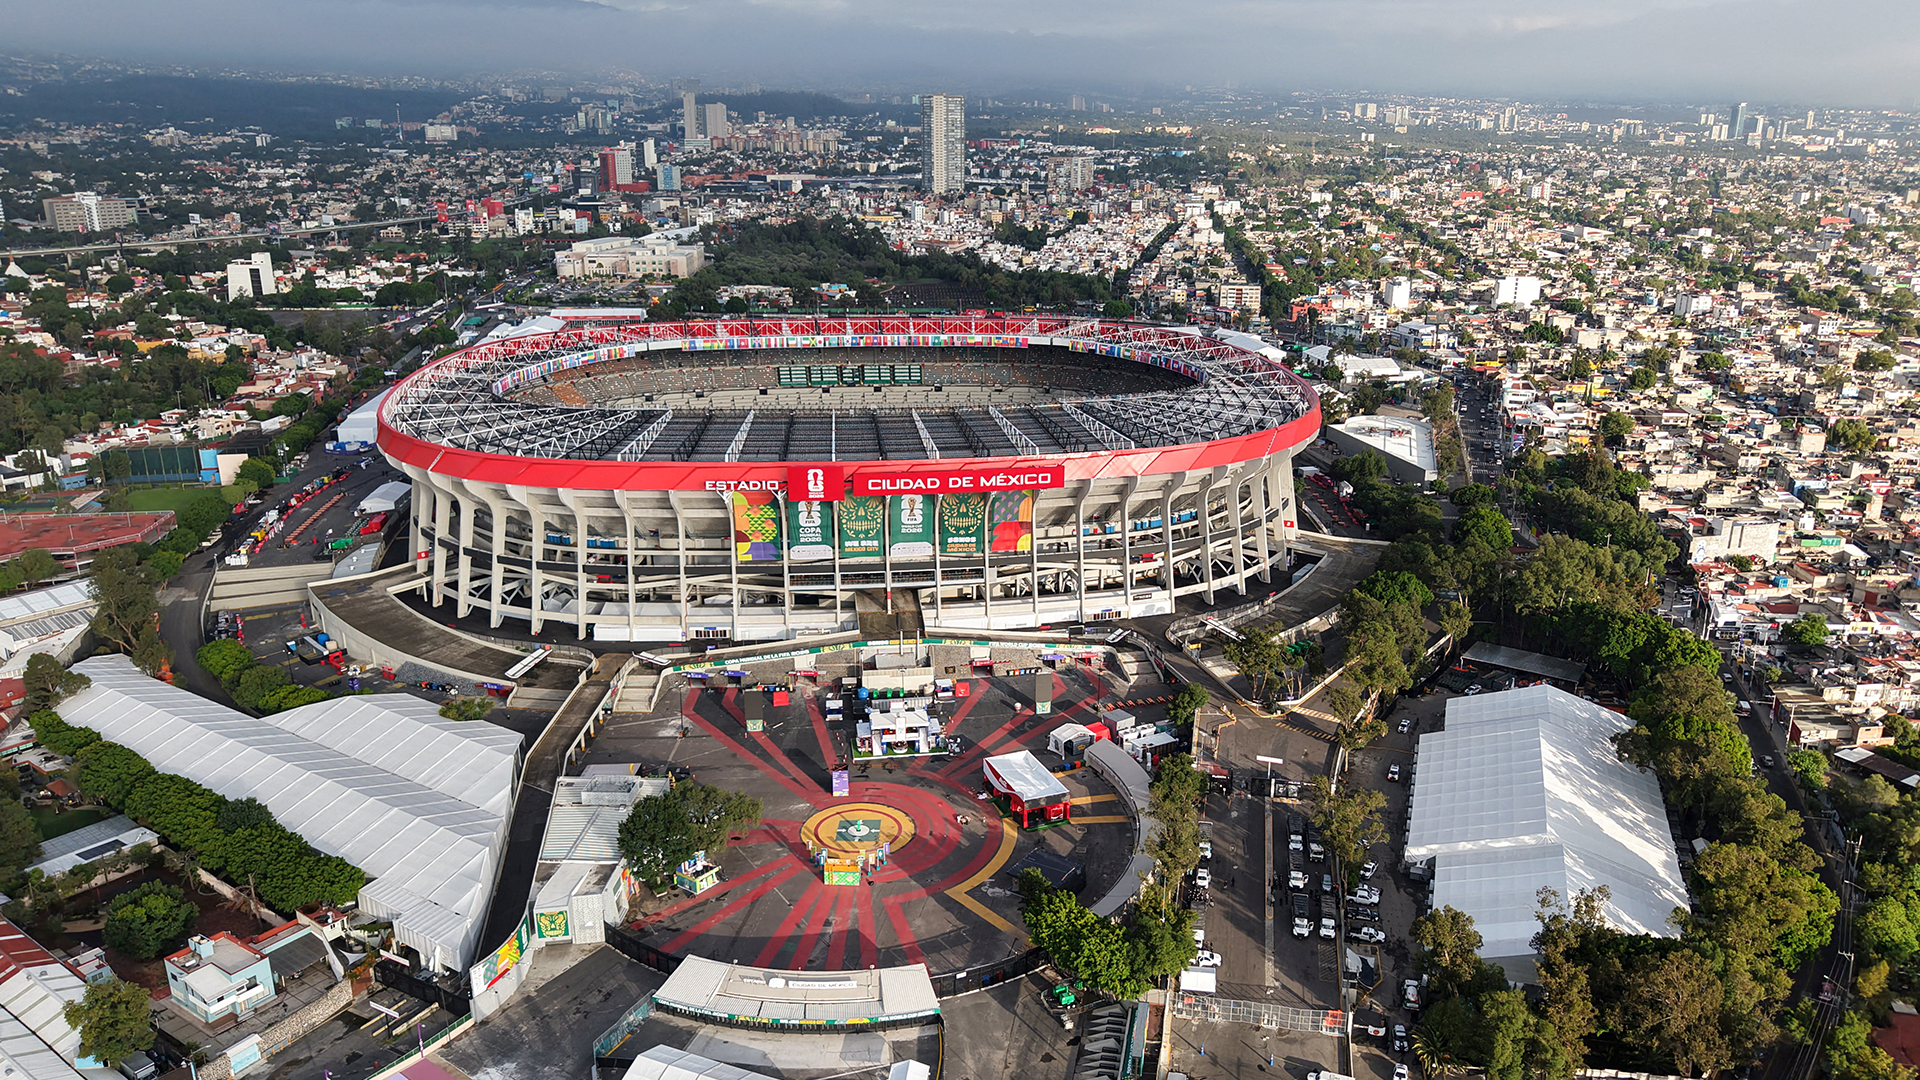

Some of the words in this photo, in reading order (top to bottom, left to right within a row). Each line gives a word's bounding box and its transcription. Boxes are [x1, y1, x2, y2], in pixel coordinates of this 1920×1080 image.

[705, 480, 779, 490] ESTADIO
[868, 478, 940, 490] CIUDAD
[948, 476, 974, 488] DE
[980, 473, 1051, 486] MÉXICO
